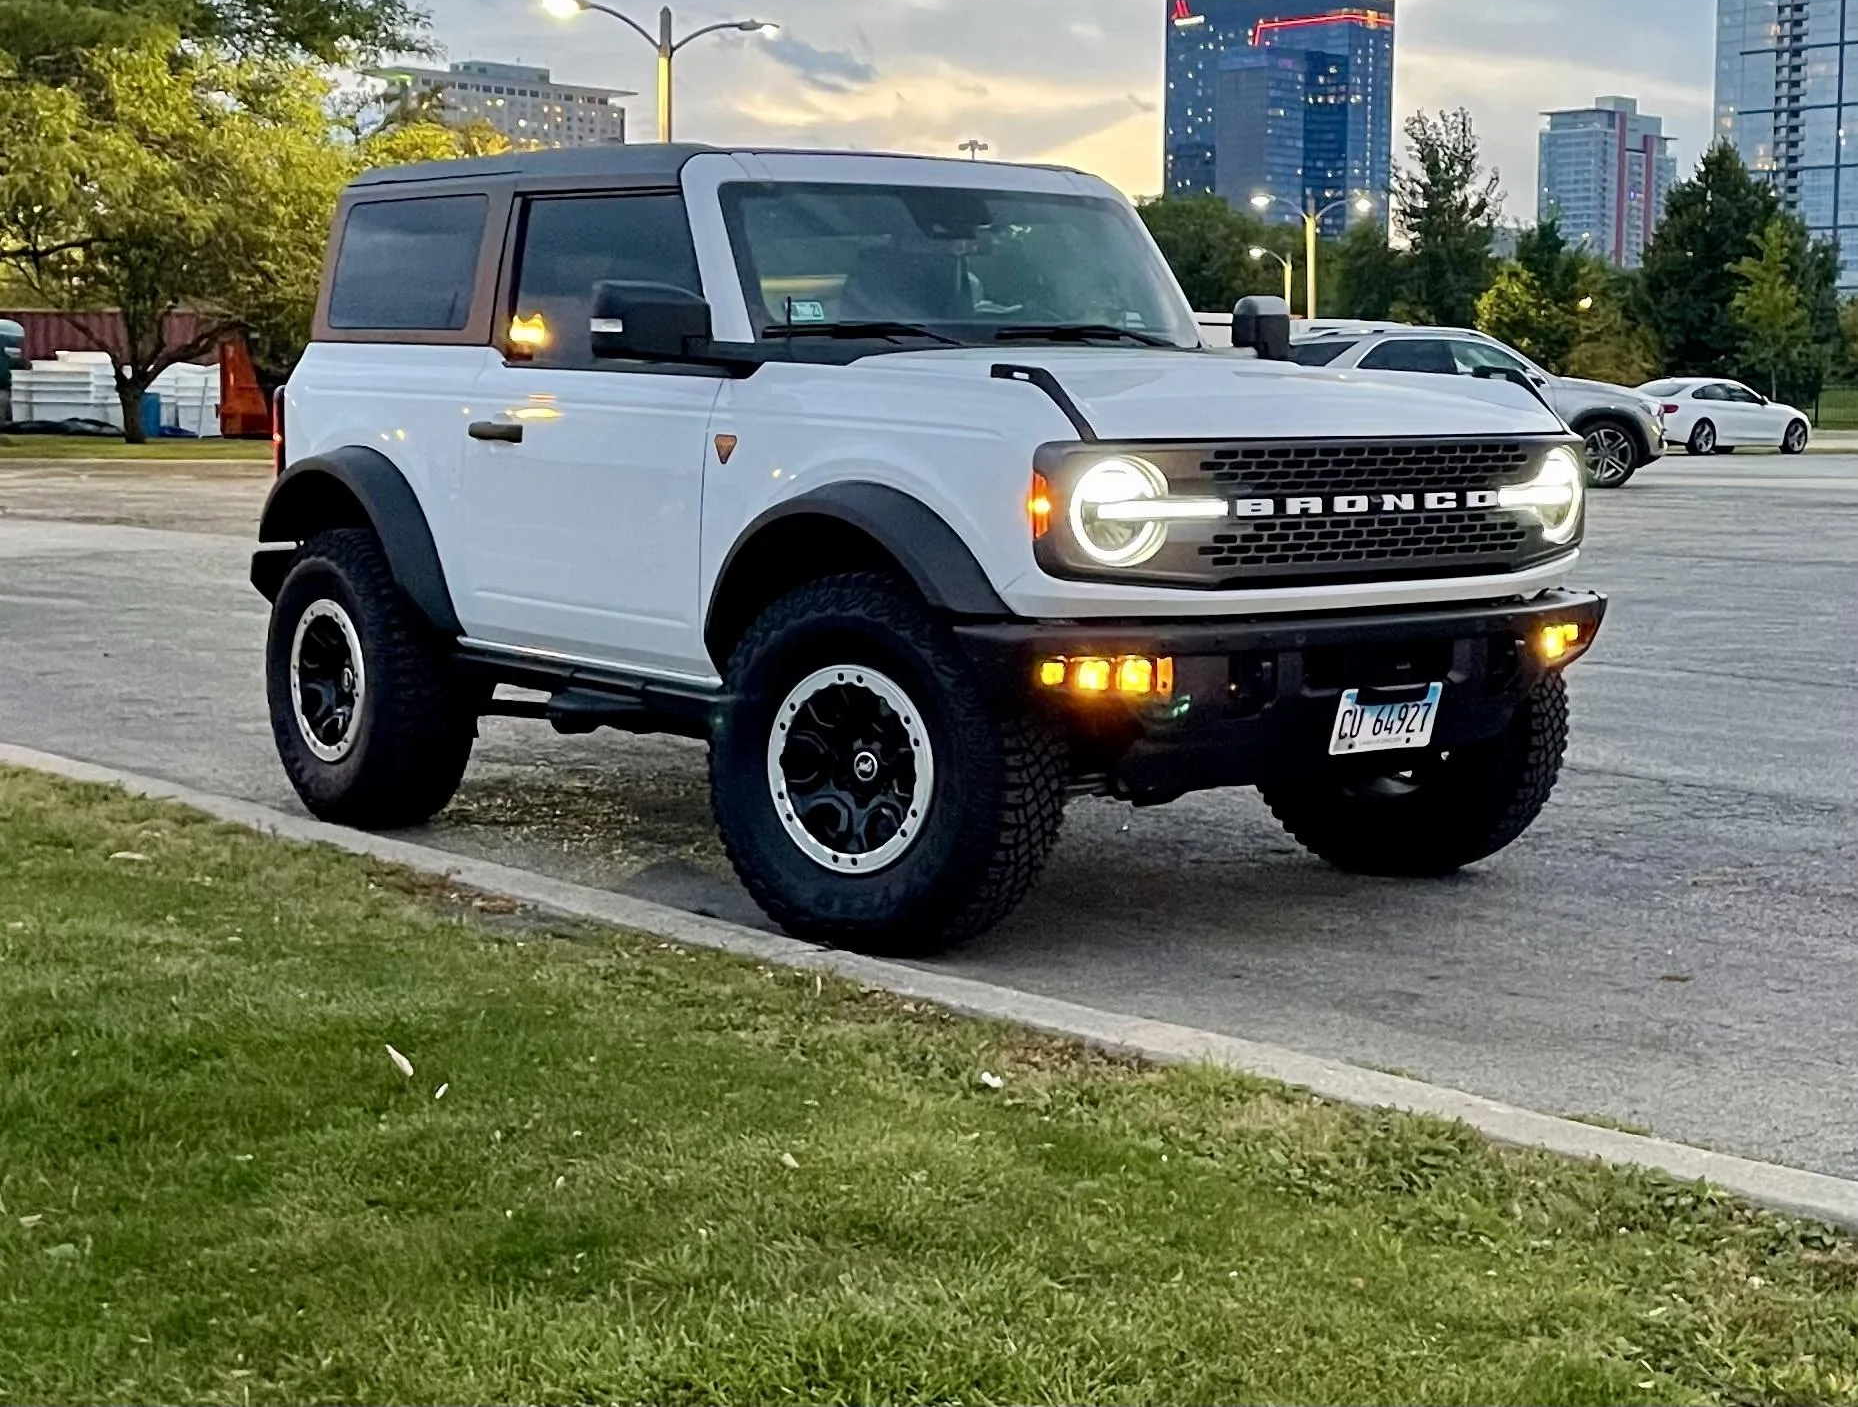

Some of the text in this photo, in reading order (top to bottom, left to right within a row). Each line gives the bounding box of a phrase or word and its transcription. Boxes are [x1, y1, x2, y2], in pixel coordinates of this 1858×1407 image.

[1236, 490, 1498, 517] BRONCO
[1338, 702, 1433, 740] CU 64927
